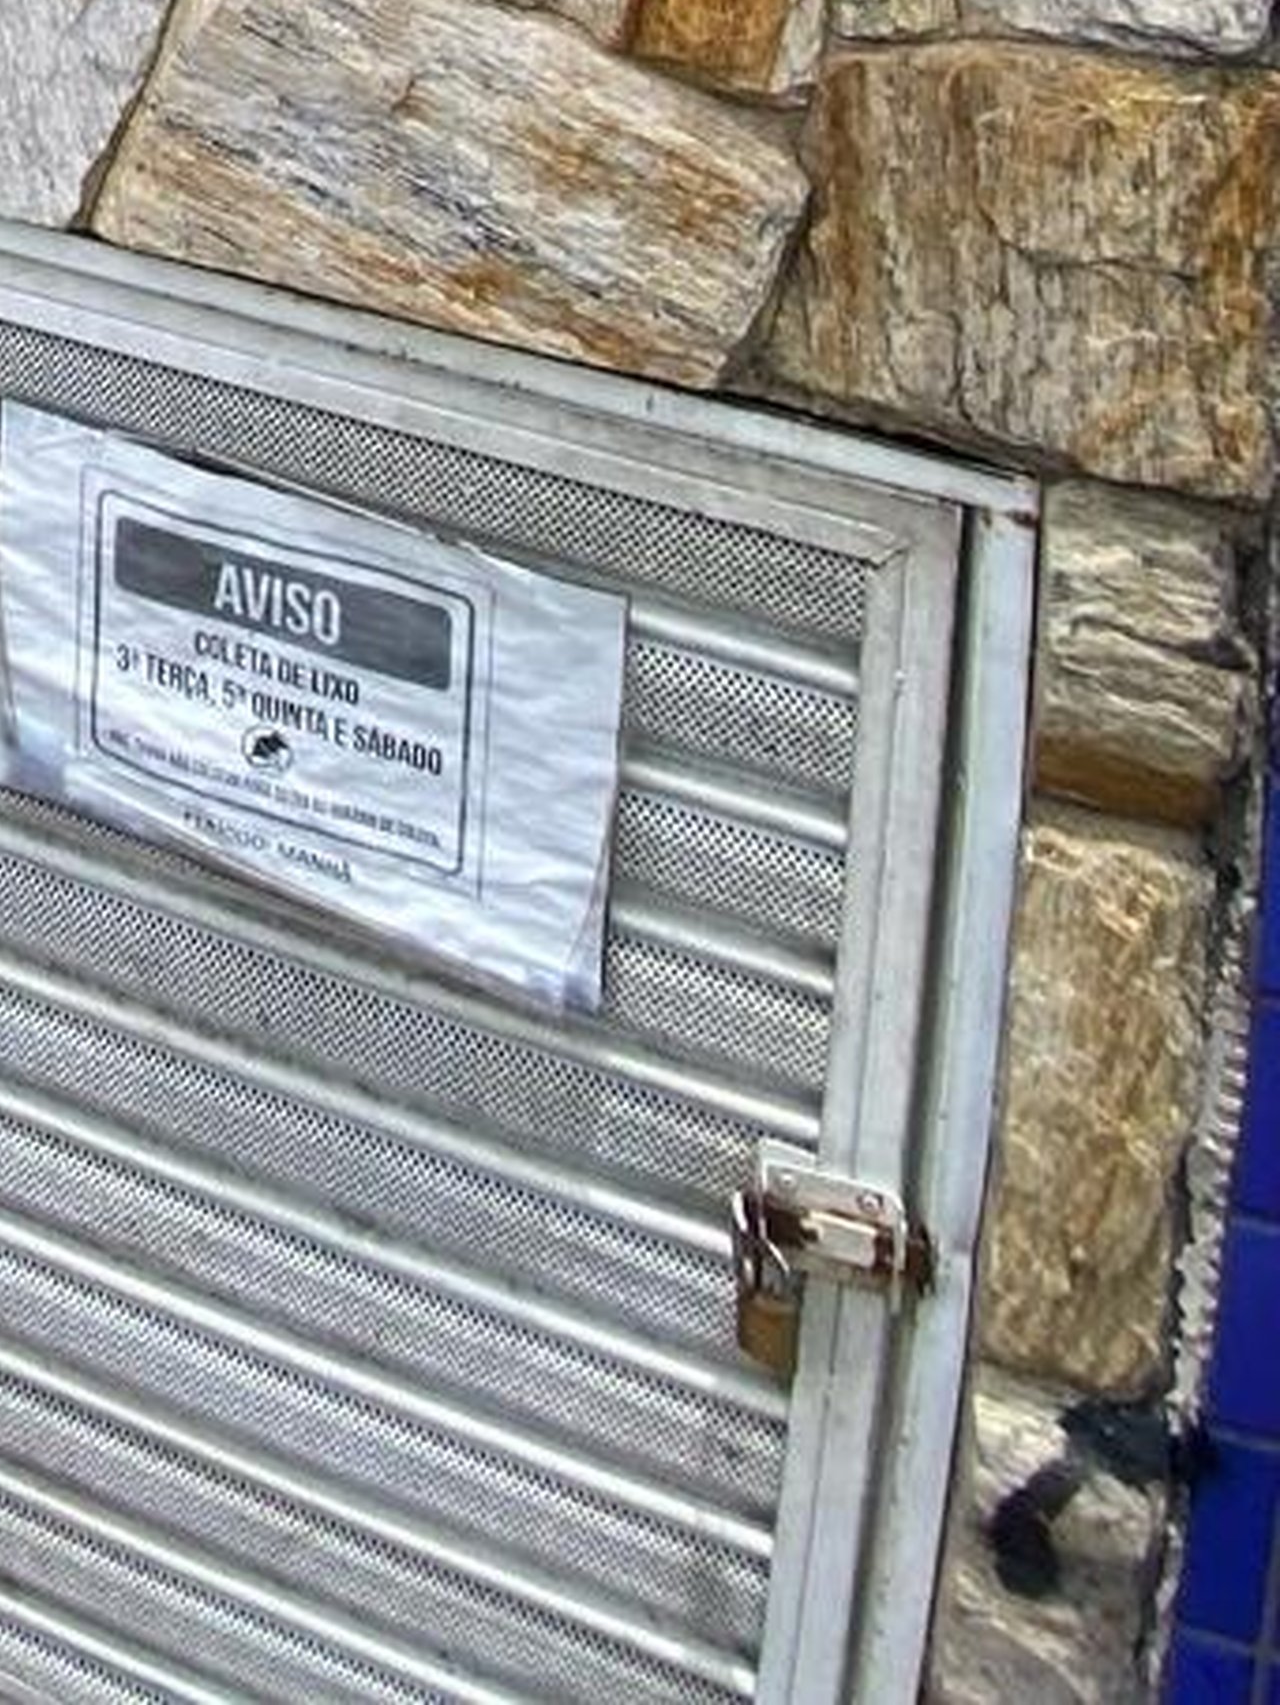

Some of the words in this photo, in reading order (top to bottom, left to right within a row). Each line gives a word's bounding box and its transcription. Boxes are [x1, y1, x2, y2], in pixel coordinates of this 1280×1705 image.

[214, 564, 341, 646] AVISO
[194, 631, 273, 679] COLETA
[278, 658, 307, 689] DE
[311, 669, 359, 706] LIXO
[251, 692, 329, 741] QUINTA
[333, 717, 348, 747] E
